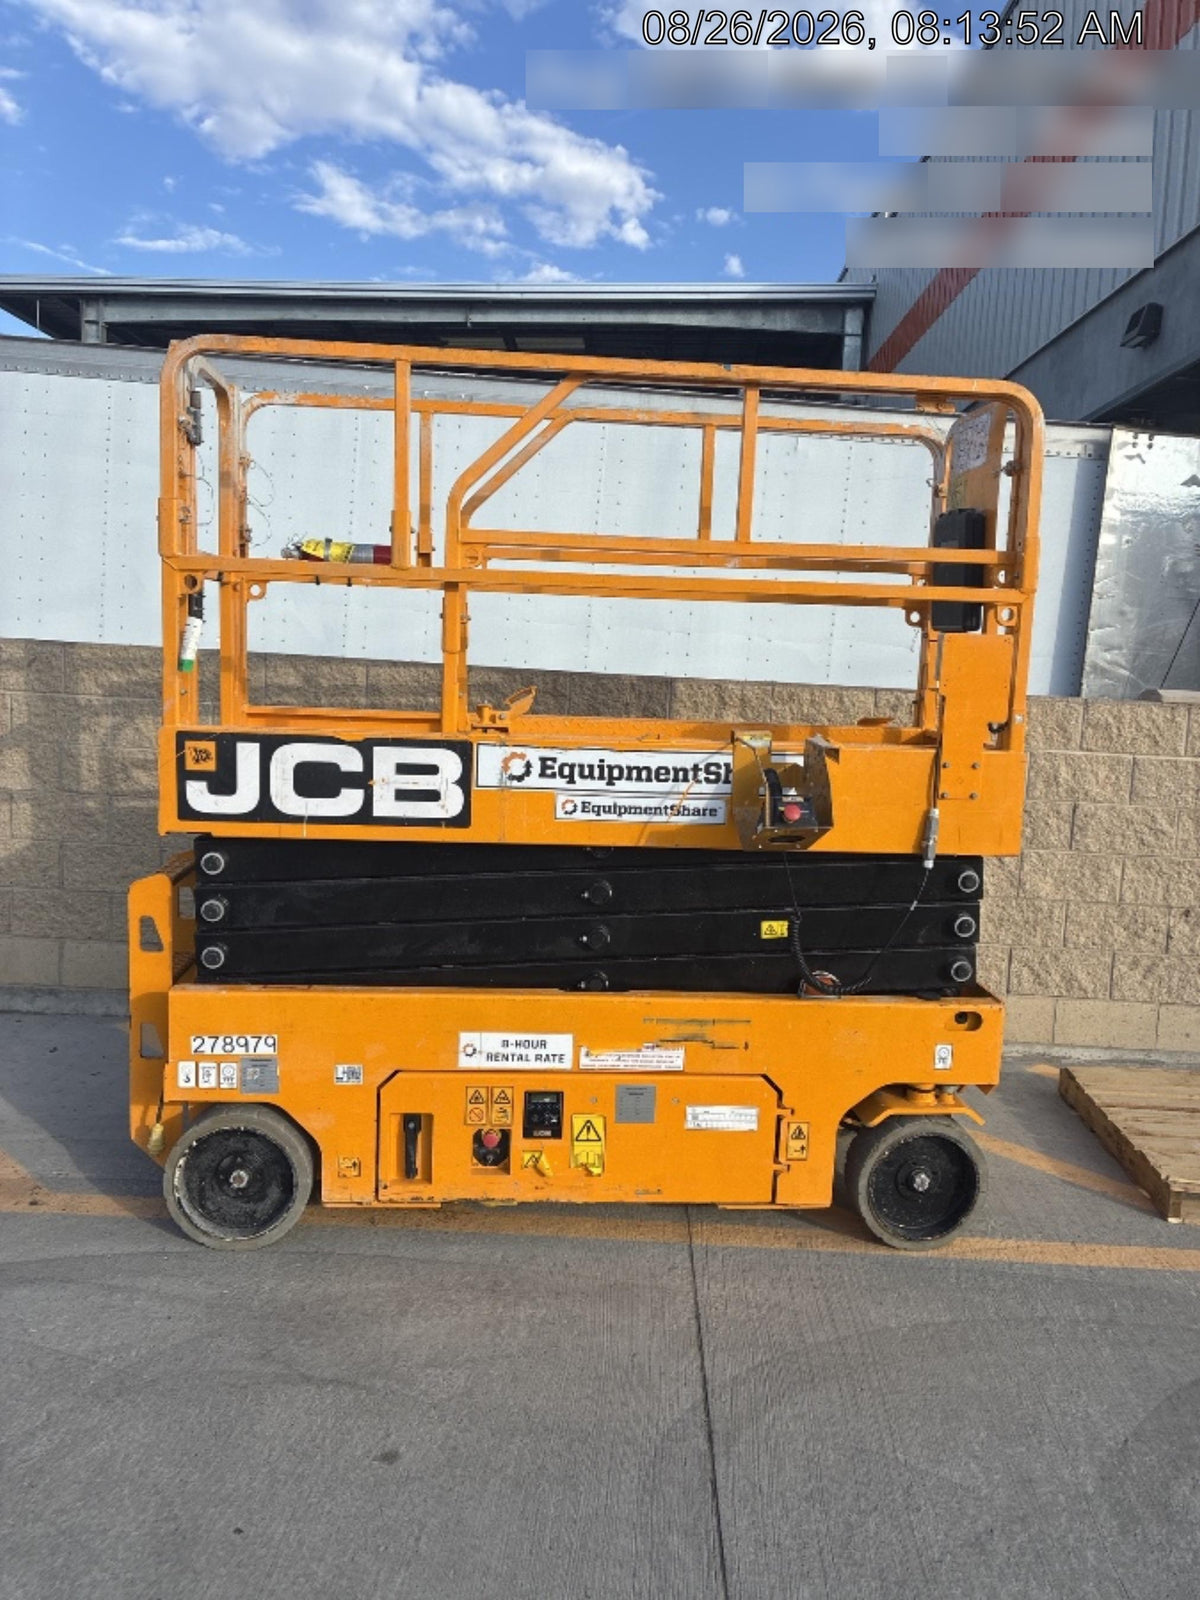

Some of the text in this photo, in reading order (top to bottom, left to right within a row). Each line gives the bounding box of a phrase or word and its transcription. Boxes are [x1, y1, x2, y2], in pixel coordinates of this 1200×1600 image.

[185, 741, 465, 819] JCB
[580, 801, 718, 818] EquipmentShare
[192, 1036, 277, 1054] 278979
[486, 1052, 566, 1064] RENTAL RATE
